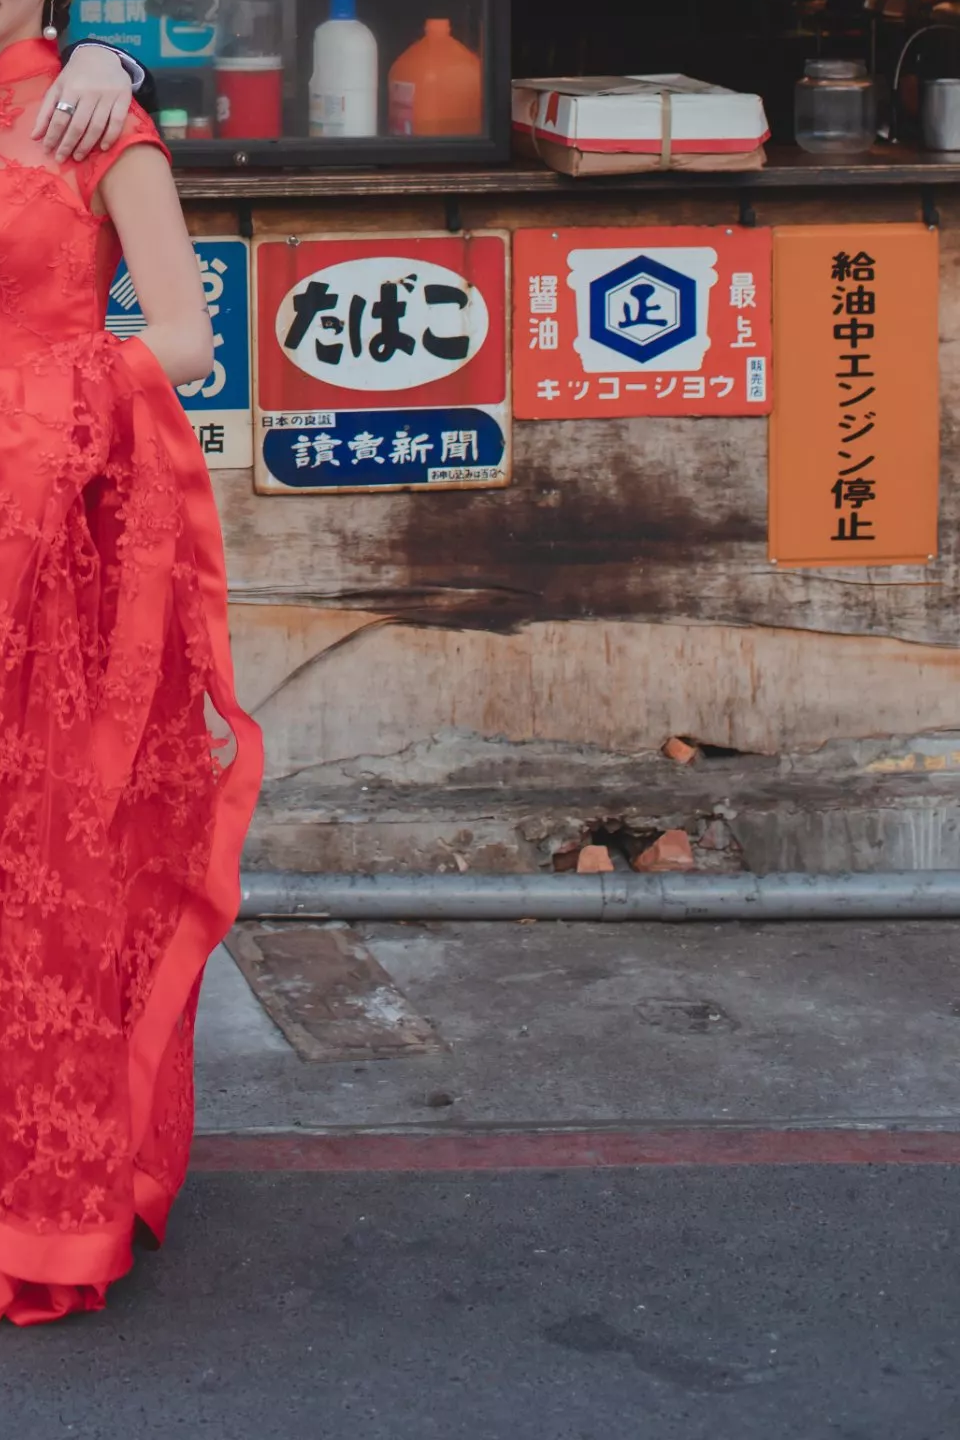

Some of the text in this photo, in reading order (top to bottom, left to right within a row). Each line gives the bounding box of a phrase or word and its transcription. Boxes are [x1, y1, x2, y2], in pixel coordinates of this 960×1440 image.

[284, 273, 470, 365] たばこ
[729, 273, 757, 349] 最上
[262, 413, 333, 428] 日本の良識
[830, 250, 877, 542] 給油中エンジン停止
